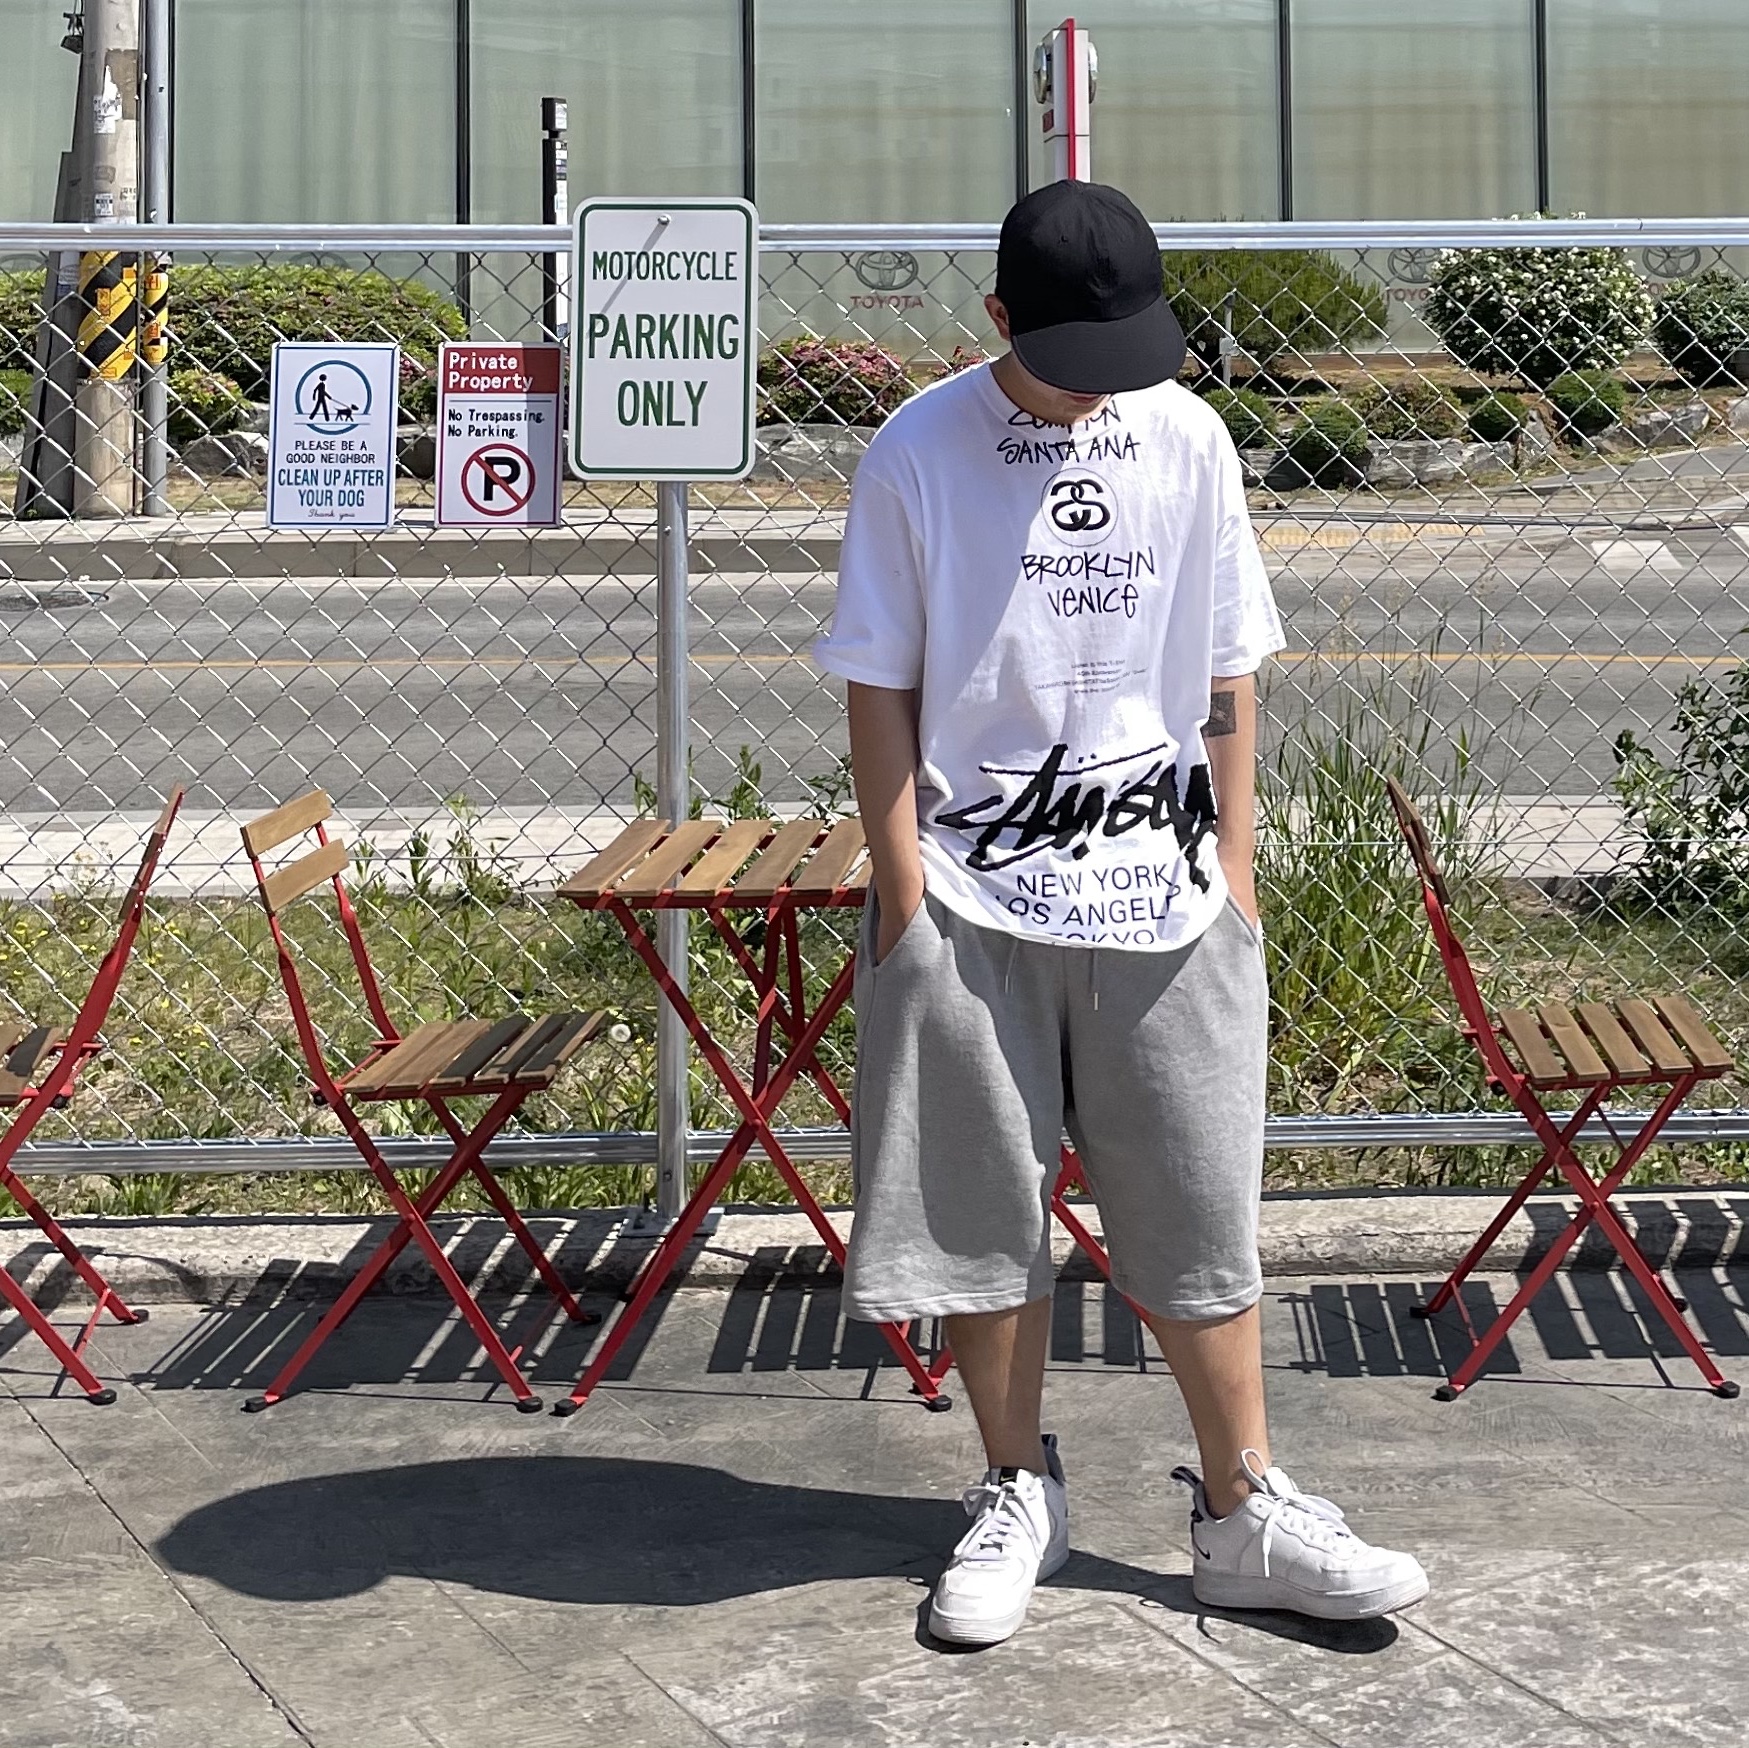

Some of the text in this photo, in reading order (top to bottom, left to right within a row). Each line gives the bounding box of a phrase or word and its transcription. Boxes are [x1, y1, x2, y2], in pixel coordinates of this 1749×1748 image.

[592, 251, 738, 281] MOTORCYCLE
[850, 295, 924, 309] TOYOTA
[588, 313, 739, 359] PARKING
[449, 352, 518, 370] Private
[449, 371, 534, 392] Property
[617, 380, 708, 427] ONLY
[448, 409, 546, 424] No Trespassing.
[448, 424, 519, 439] No Parking.
[295, 440, 368, 451] PLEASE BE A
[997, 432, 1141, 464] SANTA ANA
[286, 453, 376, 464] GOOD NEIGHBOR
[278, 468, 384, 486] CLEAN UP AFTER
[298, 489, 365, 507] YOUR DOG
[308, 508, 335, 518] Thank
[1021, 546, 1155, 584] BROOKLYN
[1017, 863, 1172, 898] NEW YORK
[996, 885, 1181, 926] OS ANGEL
